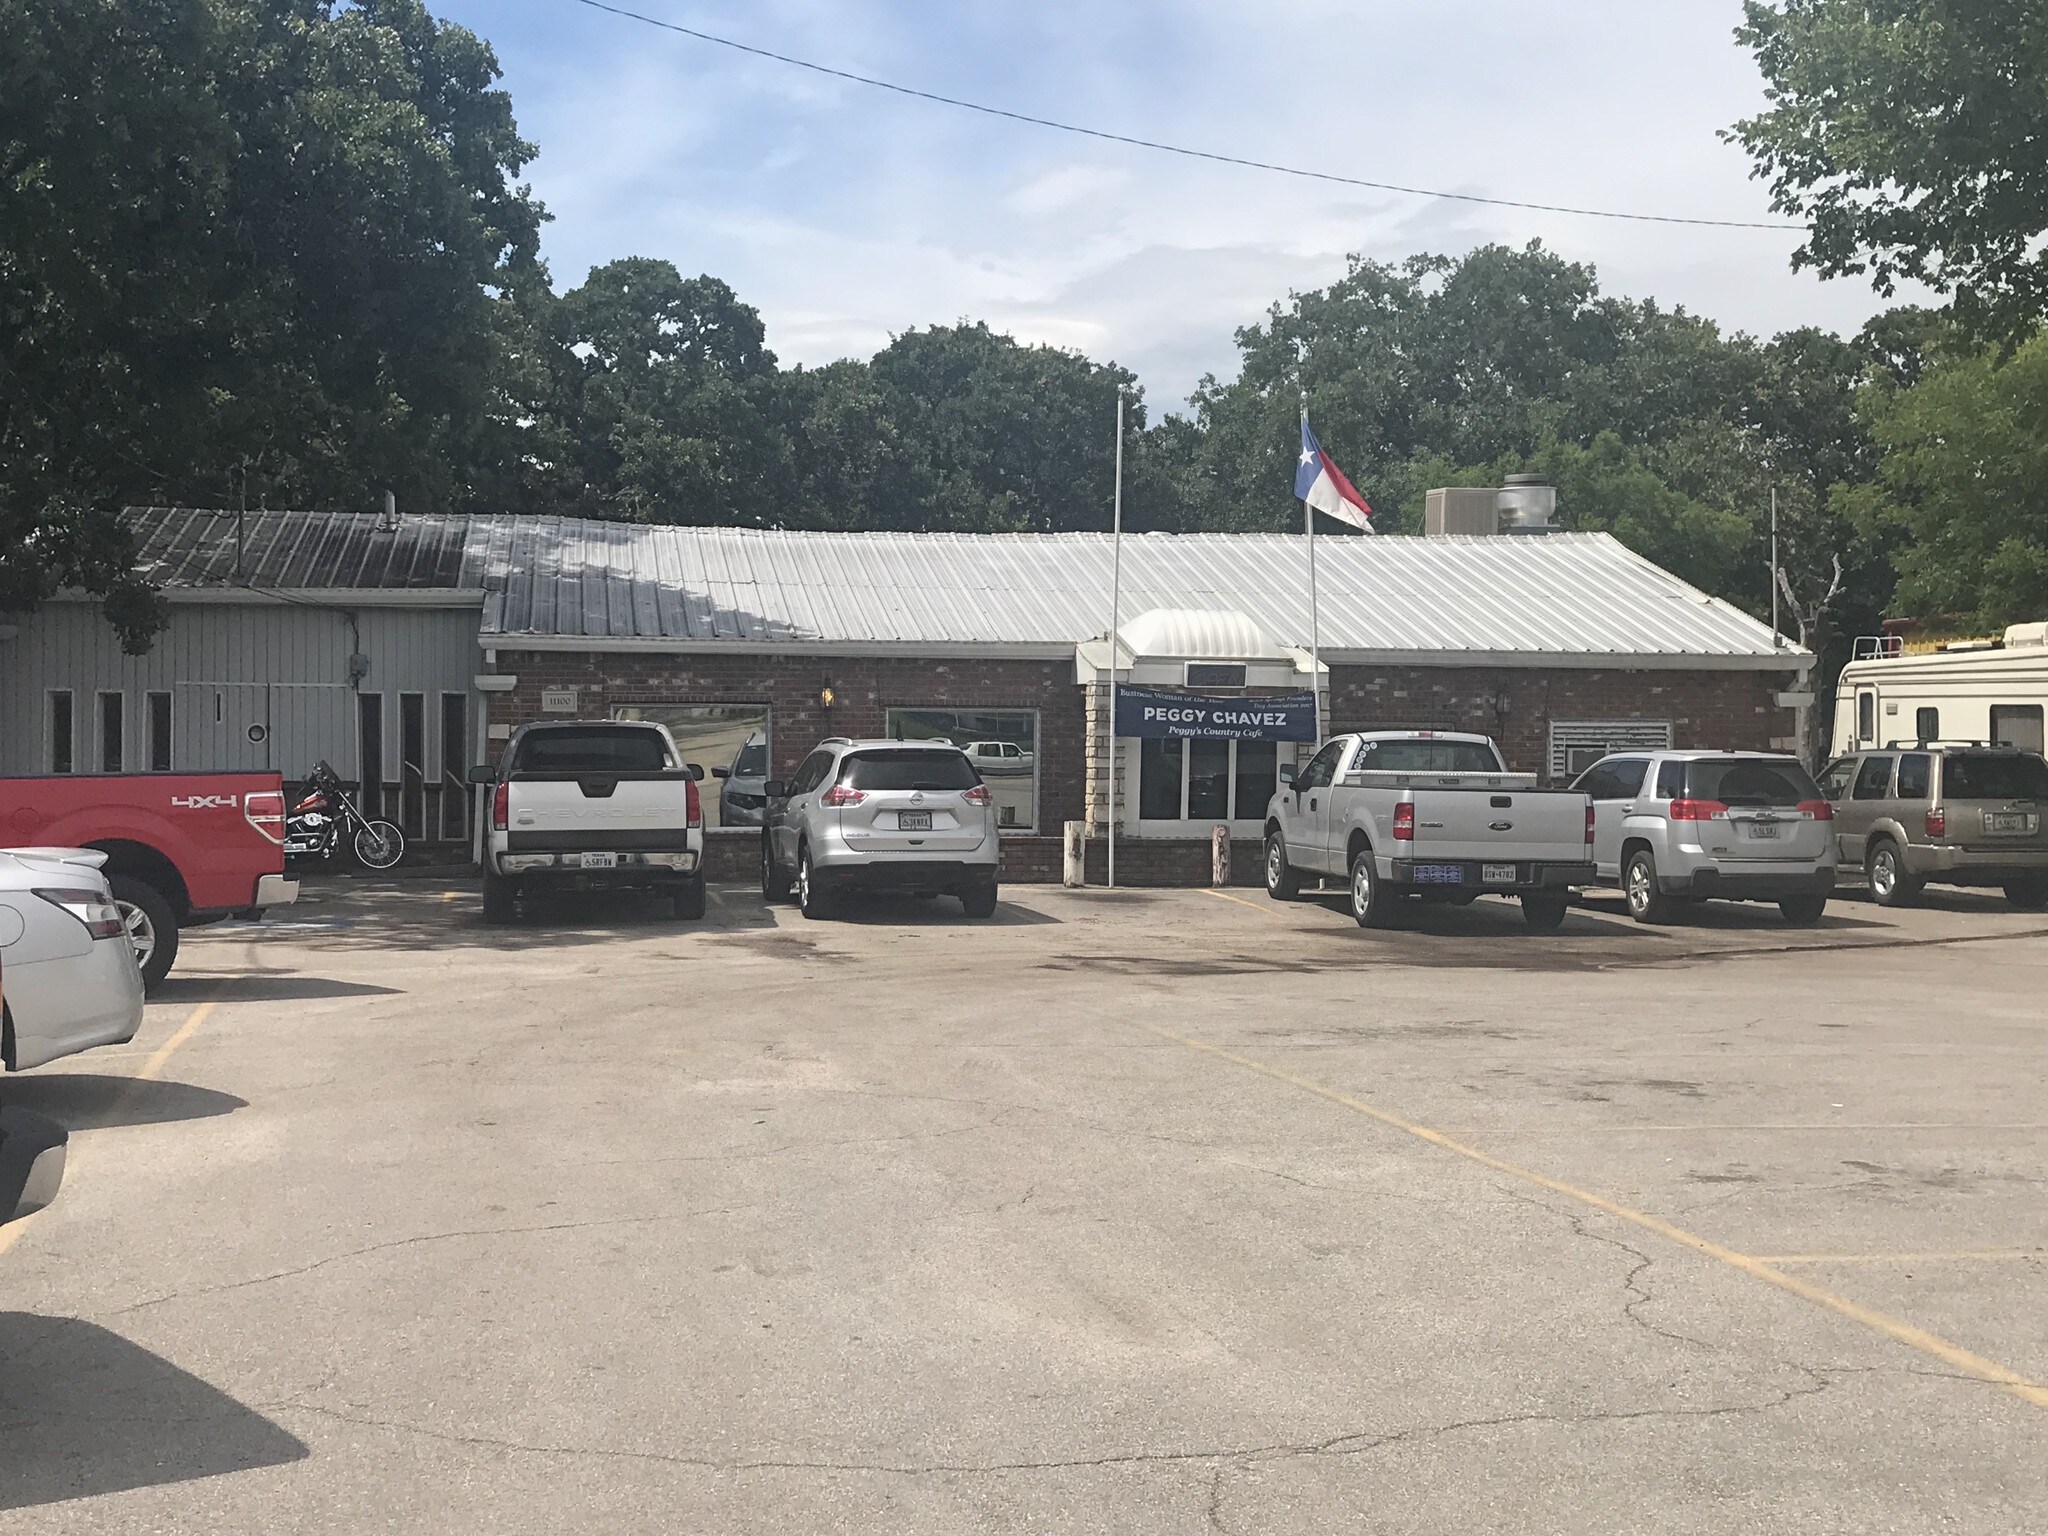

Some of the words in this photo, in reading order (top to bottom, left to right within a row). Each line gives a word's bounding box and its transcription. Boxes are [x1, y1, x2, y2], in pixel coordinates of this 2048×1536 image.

[549, 697, 571, 705] 11100
[1120, 688, 1153, 698] Business
[1154, 692, 1183, 702] Woman
[1144, 707, 1206, 723] PEGGY
[1212, 711, 1287, 726] CHAVEZ
[1168, 725, 1202, 736] Peggy's
[1203, 727, 1241, 738] Country
[1242, 728, 1263, 738] Cafe
[518, 808, 677, 819] CHEVROLET
